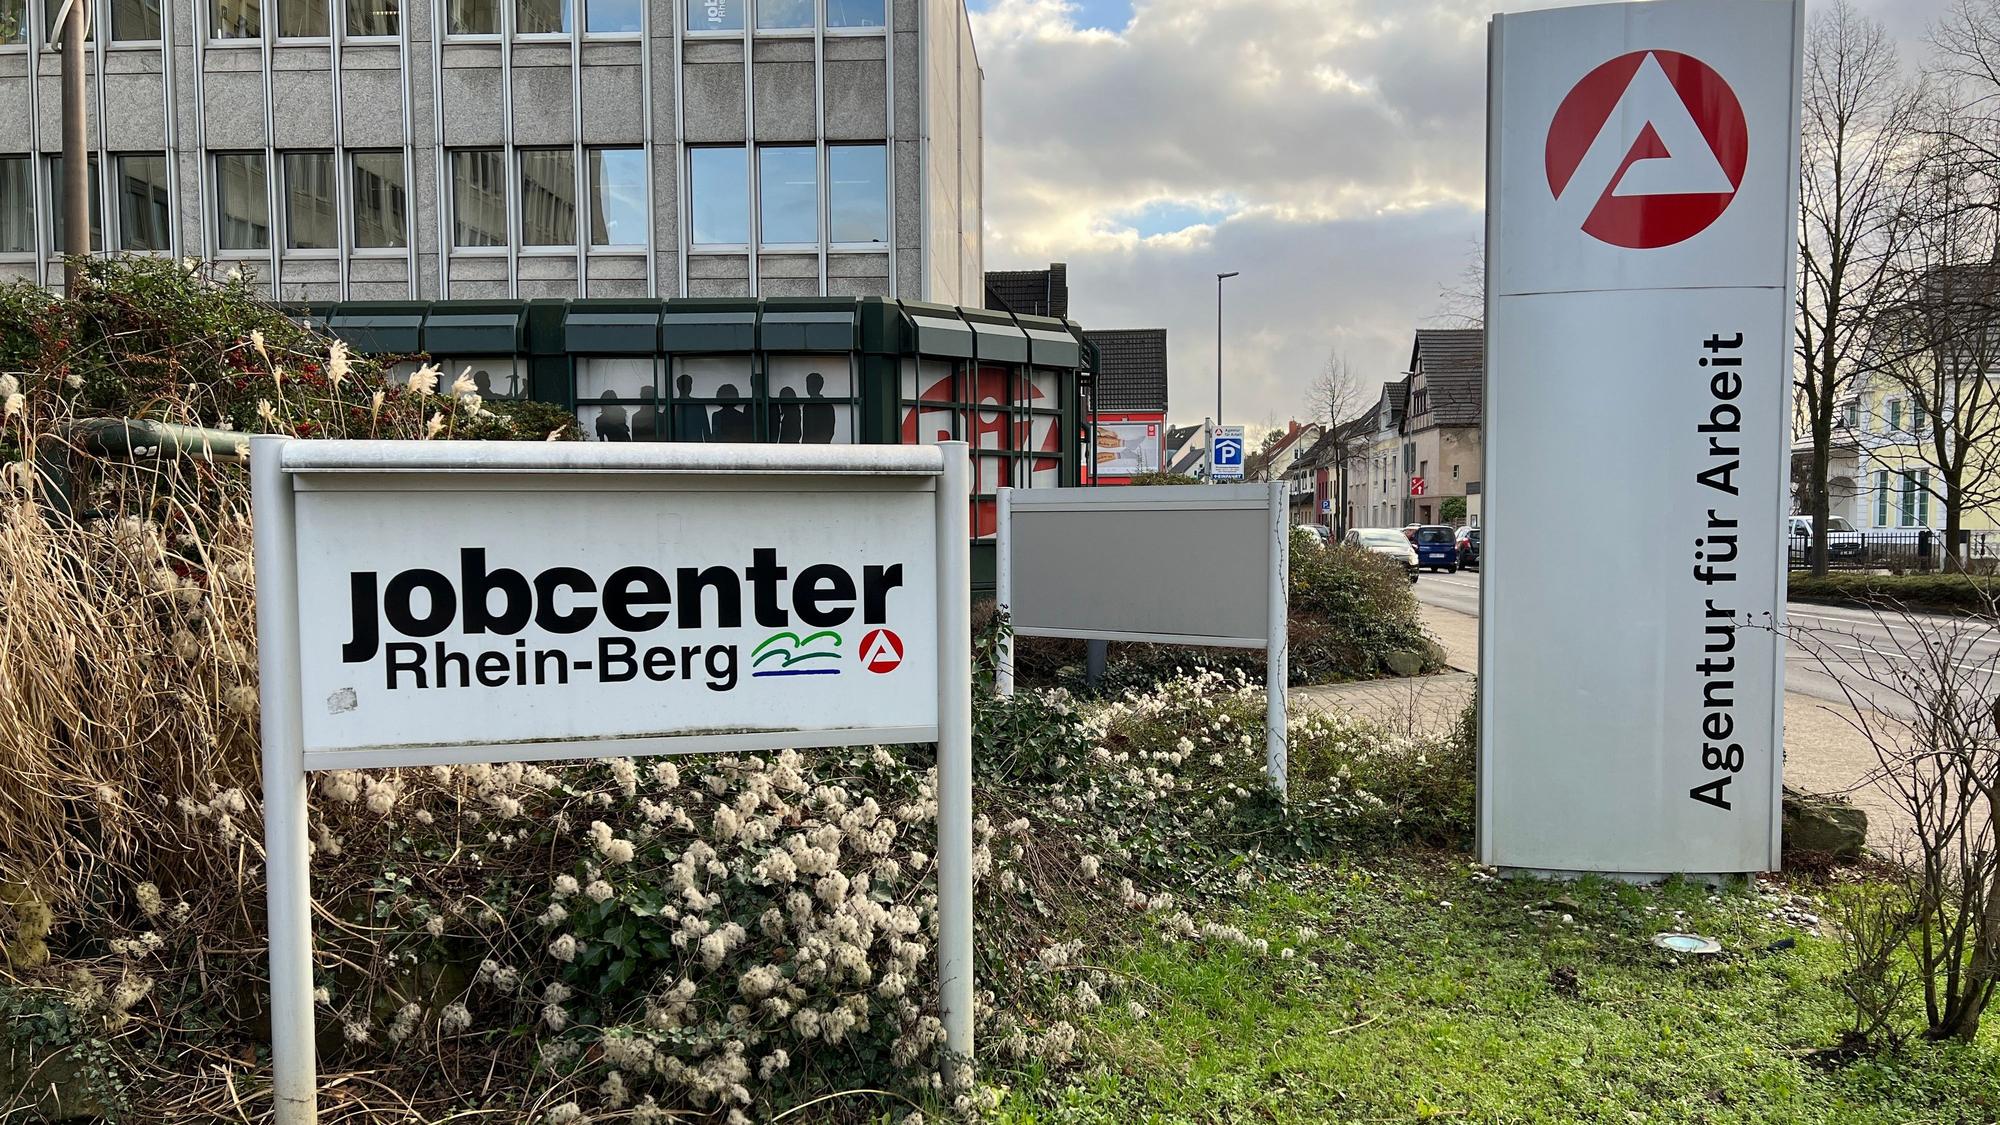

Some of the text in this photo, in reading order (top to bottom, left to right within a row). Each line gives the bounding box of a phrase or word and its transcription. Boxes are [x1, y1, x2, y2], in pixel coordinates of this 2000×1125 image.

[1221, 446, 1236, 464] P
[1690, 332, 1745, 811] Agentur für Arbeit
[385, 637, 738, 692] Rhein-Berg
